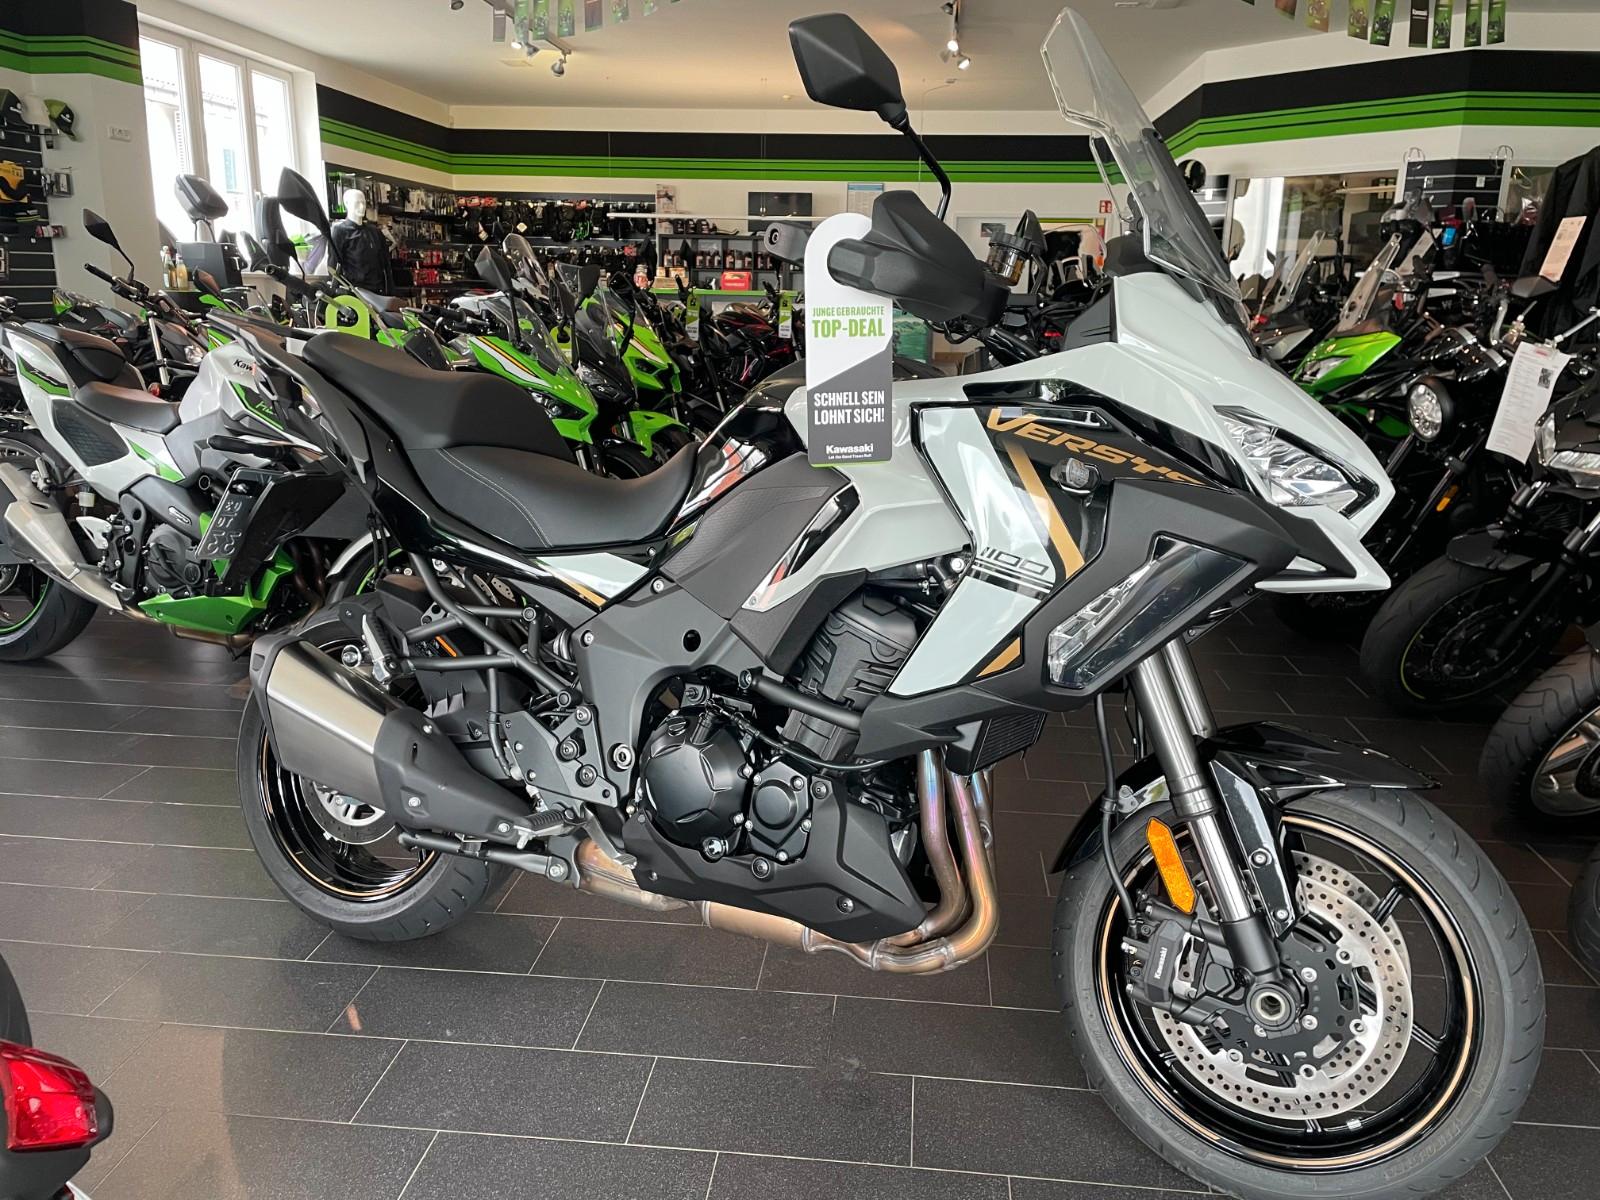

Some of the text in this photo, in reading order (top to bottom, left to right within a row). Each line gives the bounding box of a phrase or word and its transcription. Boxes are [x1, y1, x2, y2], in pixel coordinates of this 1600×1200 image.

[813, 305, 885, 317] JUNGE GEBRAUCHTE
[812, 318, 886, 338] TOP-DEAL
[813, 390, 885, 407] SCHNELL SEIN
[814, 407, 885, 425] LOHNT SICH!
[826, 443, 874, 454] Kawasaki
